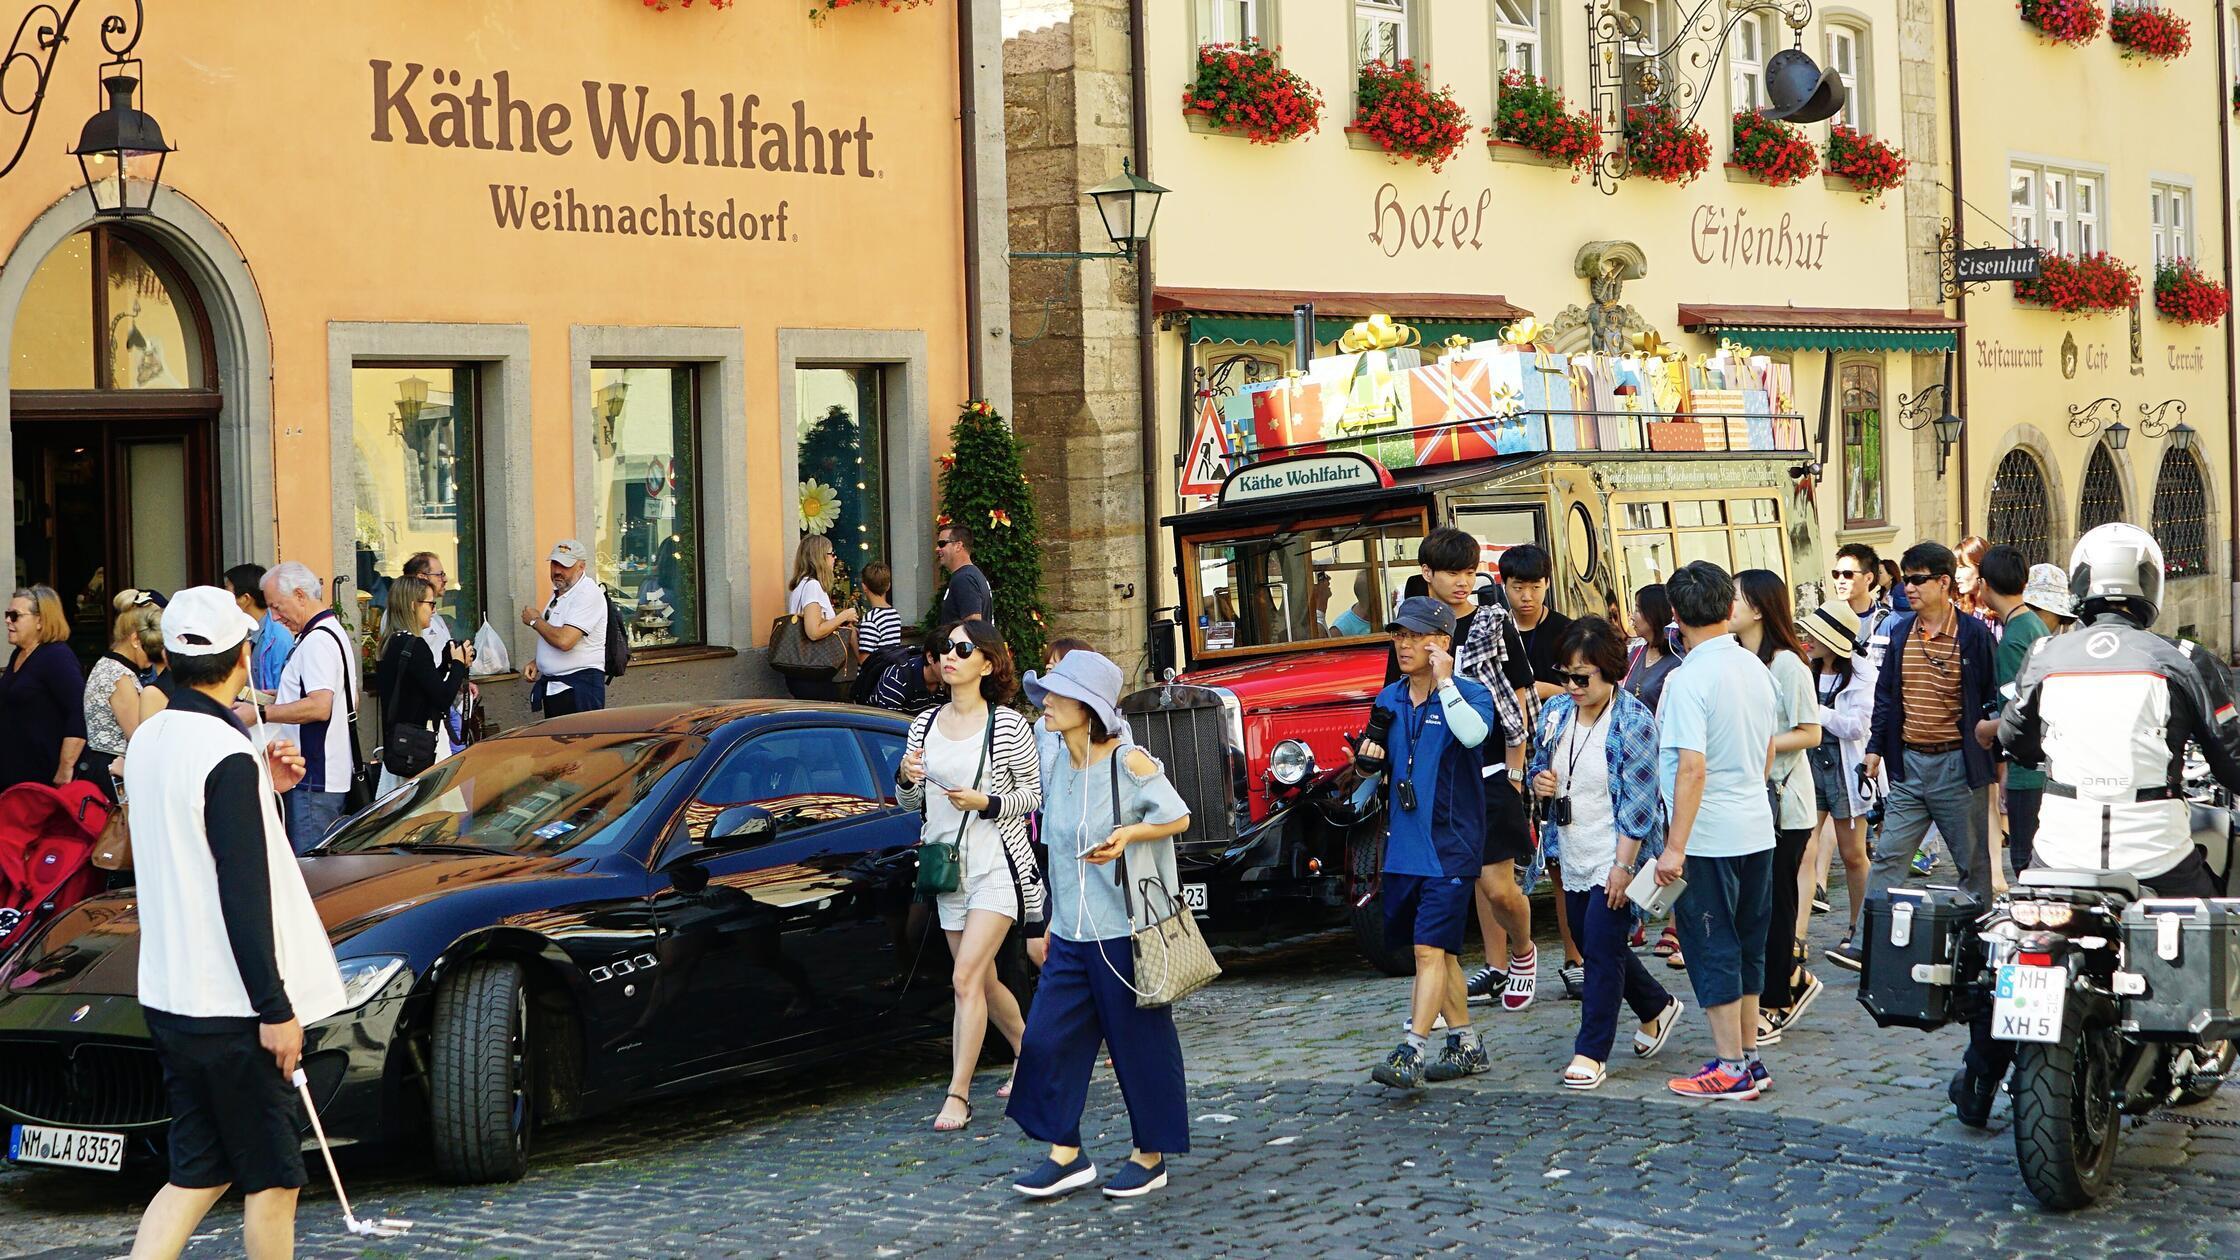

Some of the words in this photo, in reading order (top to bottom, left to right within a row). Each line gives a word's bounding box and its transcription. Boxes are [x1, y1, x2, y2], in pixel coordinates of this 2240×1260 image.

[368, 58, 574, 156] Käthe
[1368, 182, 1492, 258] Hotel
[1957, 255, 2036, 277] Eisenhut
[1239, 474, 1283, 492] Käthe
[1286, 464, 1360, 487] Wohlfahrt
[2019, 971, 2048, 990] MH
[2002, 1015, 2031, 1036] XH
[2037, 1017, 2051, 1037] 5
[20, 1128, 42, 1157] NM
[50, 1131, 73, 1160] LA
[76, 1134, 121, 1166] 8352
